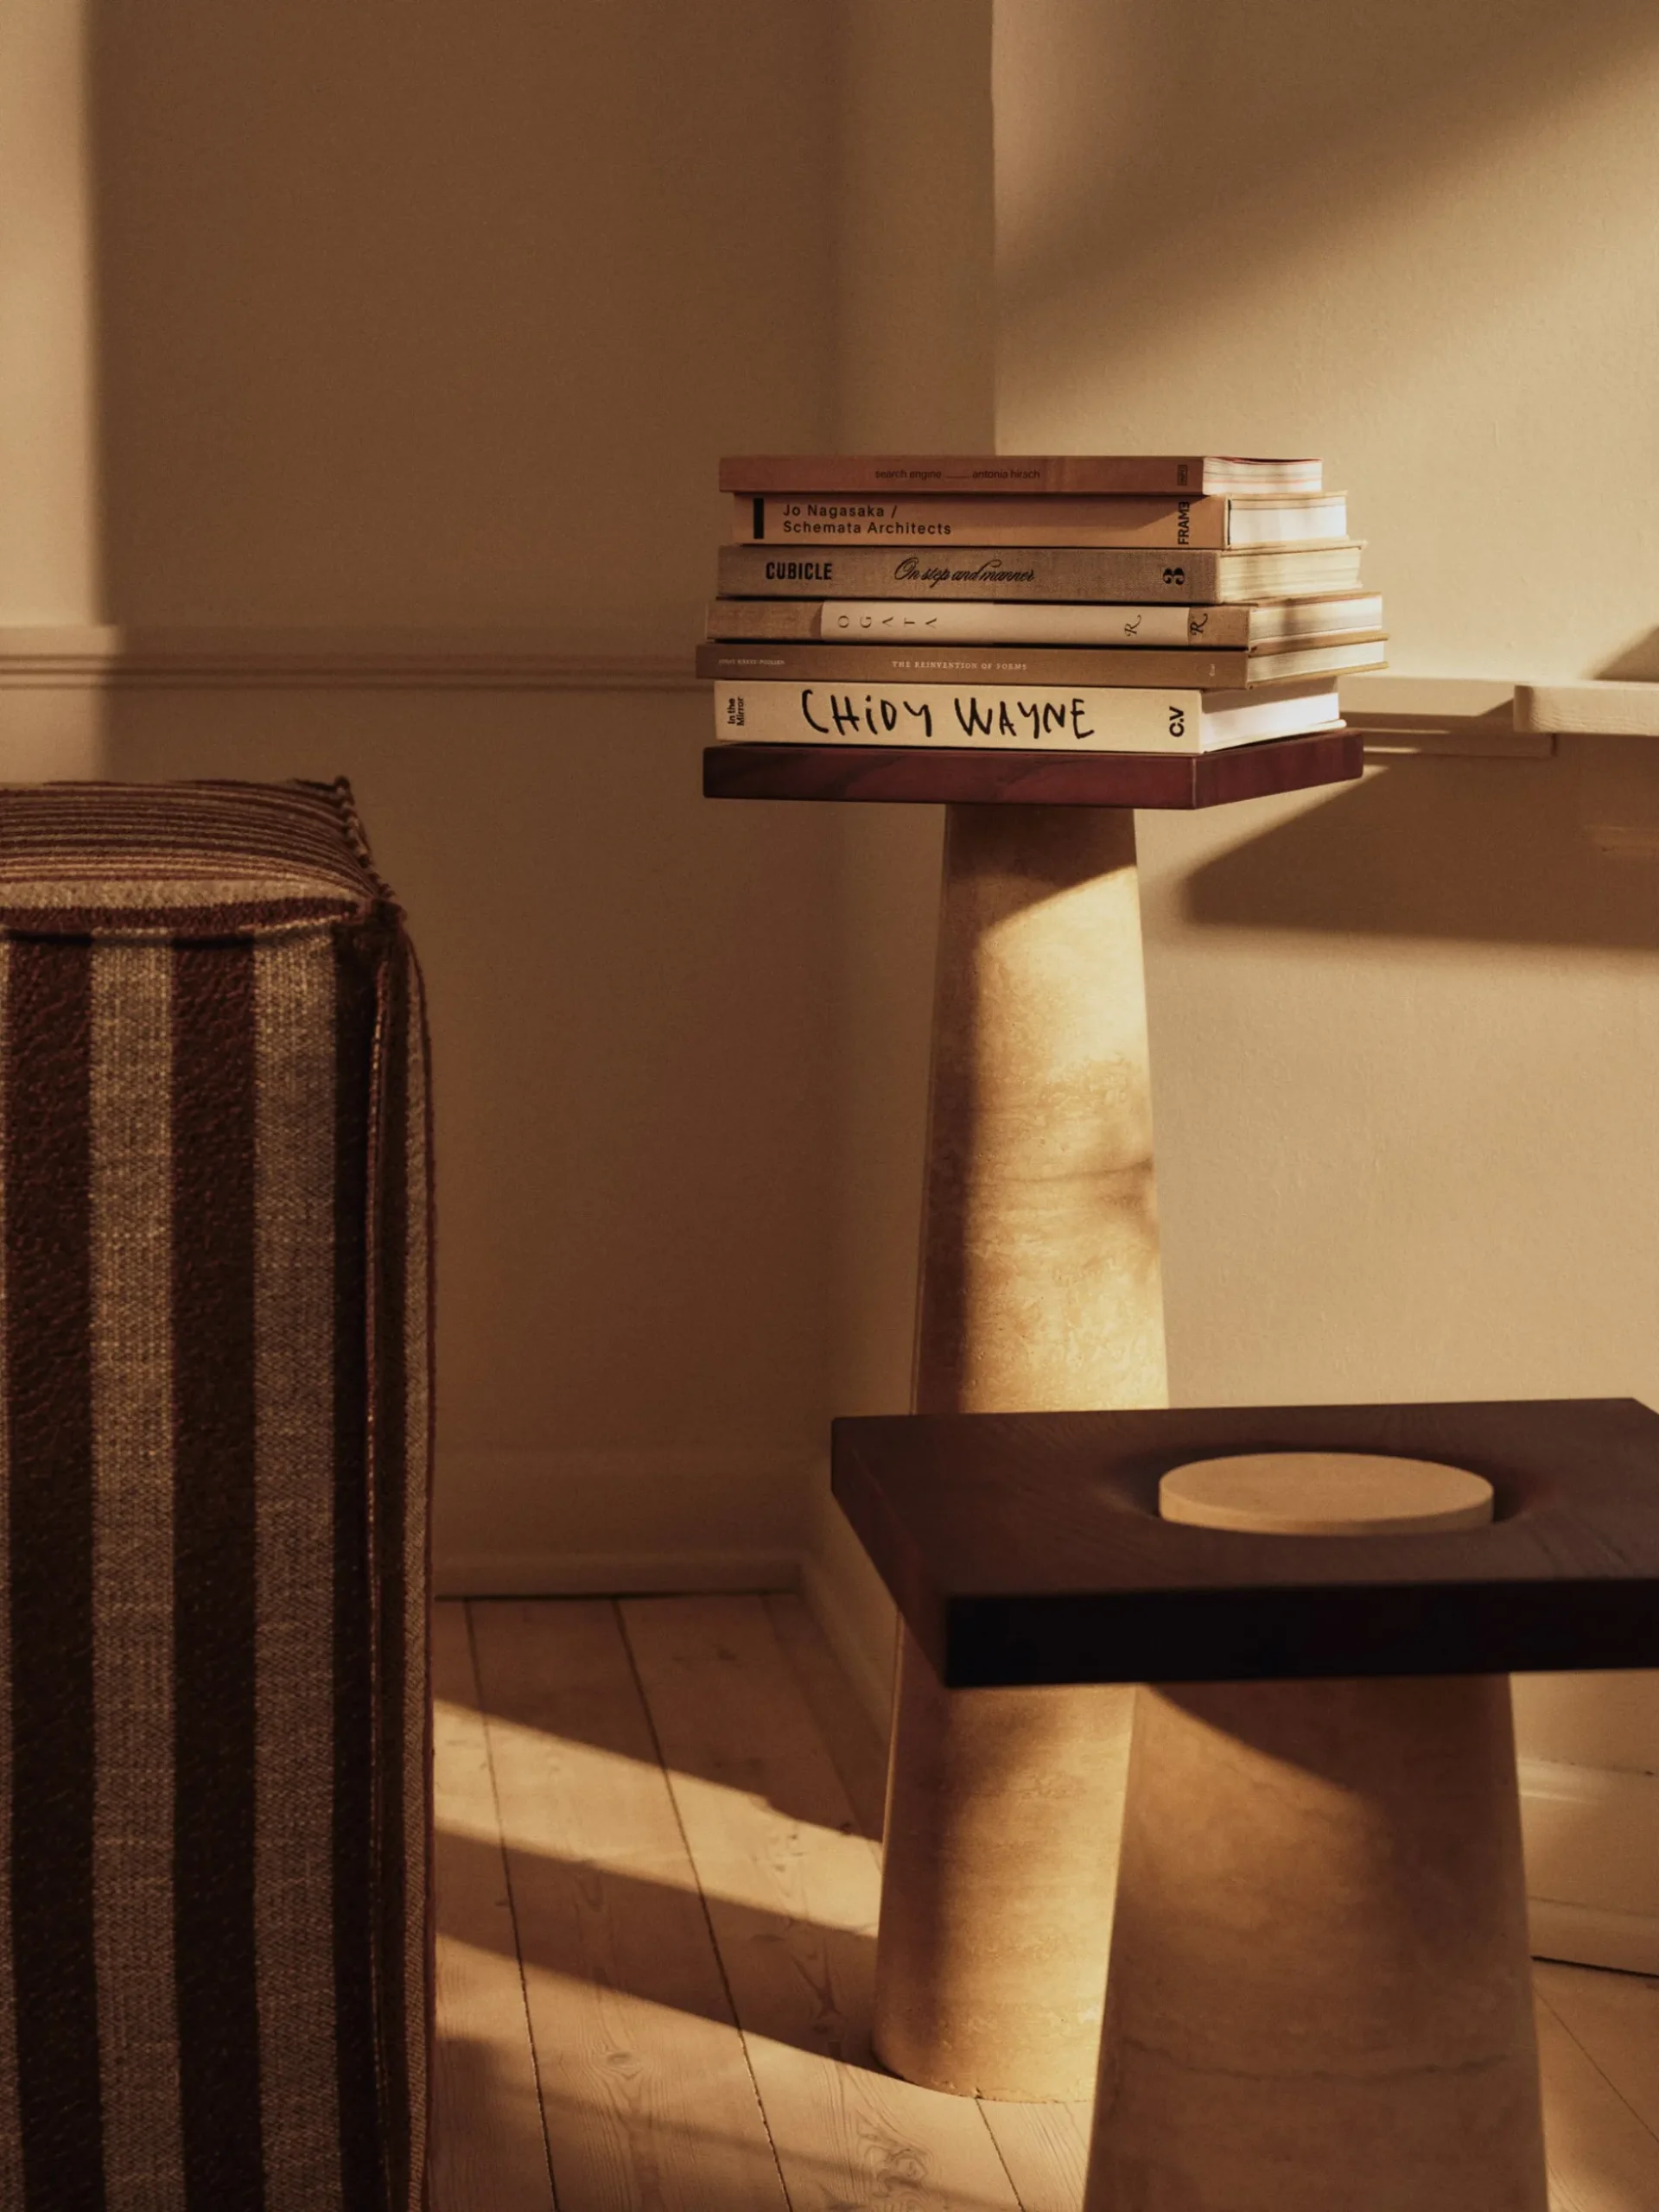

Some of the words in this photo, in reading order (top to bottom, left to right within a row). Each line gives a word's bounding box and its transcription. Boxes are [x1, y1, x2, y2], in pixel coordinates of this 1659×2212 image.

[874, 469, 906, 479] search
[972, 469, 1007, 479] antonia
[1010, 469, 1040, 479] hirsch
[783, 505, 801, 517] Jo
[807, 505, 885, 519] Nagasaka
[783, 520, 861, 534] Schemata
[867, 523, 951, 535] Architects
[766, 562, 833, 580] CUBICLE
[894, 556, 920, 581] On
[921, 567, 950, 588] step
[951, 559, 1002, 582] and
[892, 660, 912, 669] THE
[914, 661, 977, 671] REINVENTION
[996, 663, 1028, 671] FORMS
[727, 697, 736, 713] the
[736, 696, 745, 727] Mirror
[727, 715, 736, 725] In
[954, 696, 1095, 740] WAYNE
